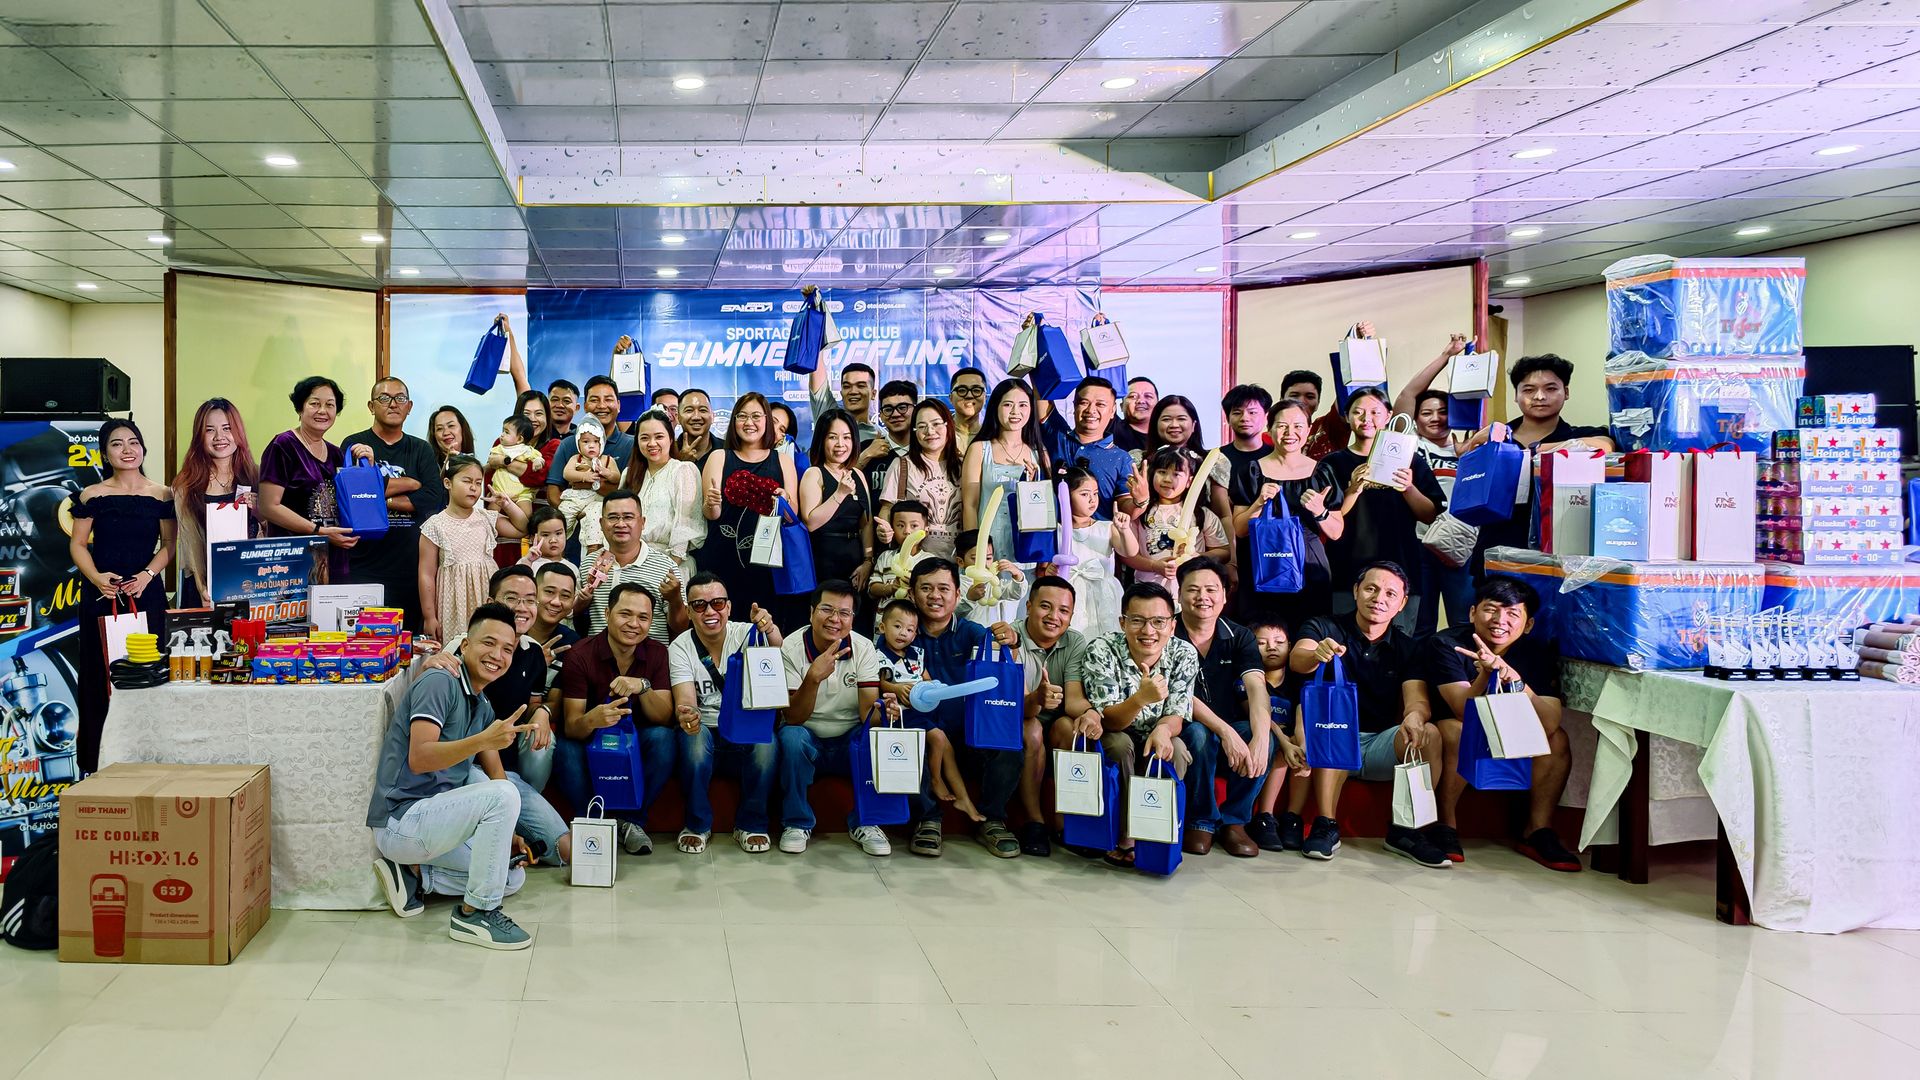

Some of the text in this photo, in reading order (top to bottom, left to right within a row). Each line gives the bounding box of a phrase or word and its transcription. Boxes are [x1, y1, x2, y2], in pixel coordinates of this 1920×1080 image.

[726, 327, 791, 341] SPORTAG
[839, 326, 859, 340] ON
[862, 326, 900, 340] CLUB
[658, 341, 787, 367] SUMME
[82, 434, 100, 443] BÓN
[1810, 485, 1843, 493] Heineken
[240, 549, 273, 560] SUMMER
[274, 547, 304, 557] OFFLINE
[268, 580, 289, 589] QUANG
[289, 577, 304, 586] FILM
[40, 577, 82, 616] Mi
[250, 600, 308, 622] 00.000
[984, 699, 1017, 708] mobifone
[1315, 722, 1348, 730] mobifone
[75, 829, 160, 842] ICE COOLER
[173, 851, 199, 866] 1.6
[160, 885, 186, 897] 637
